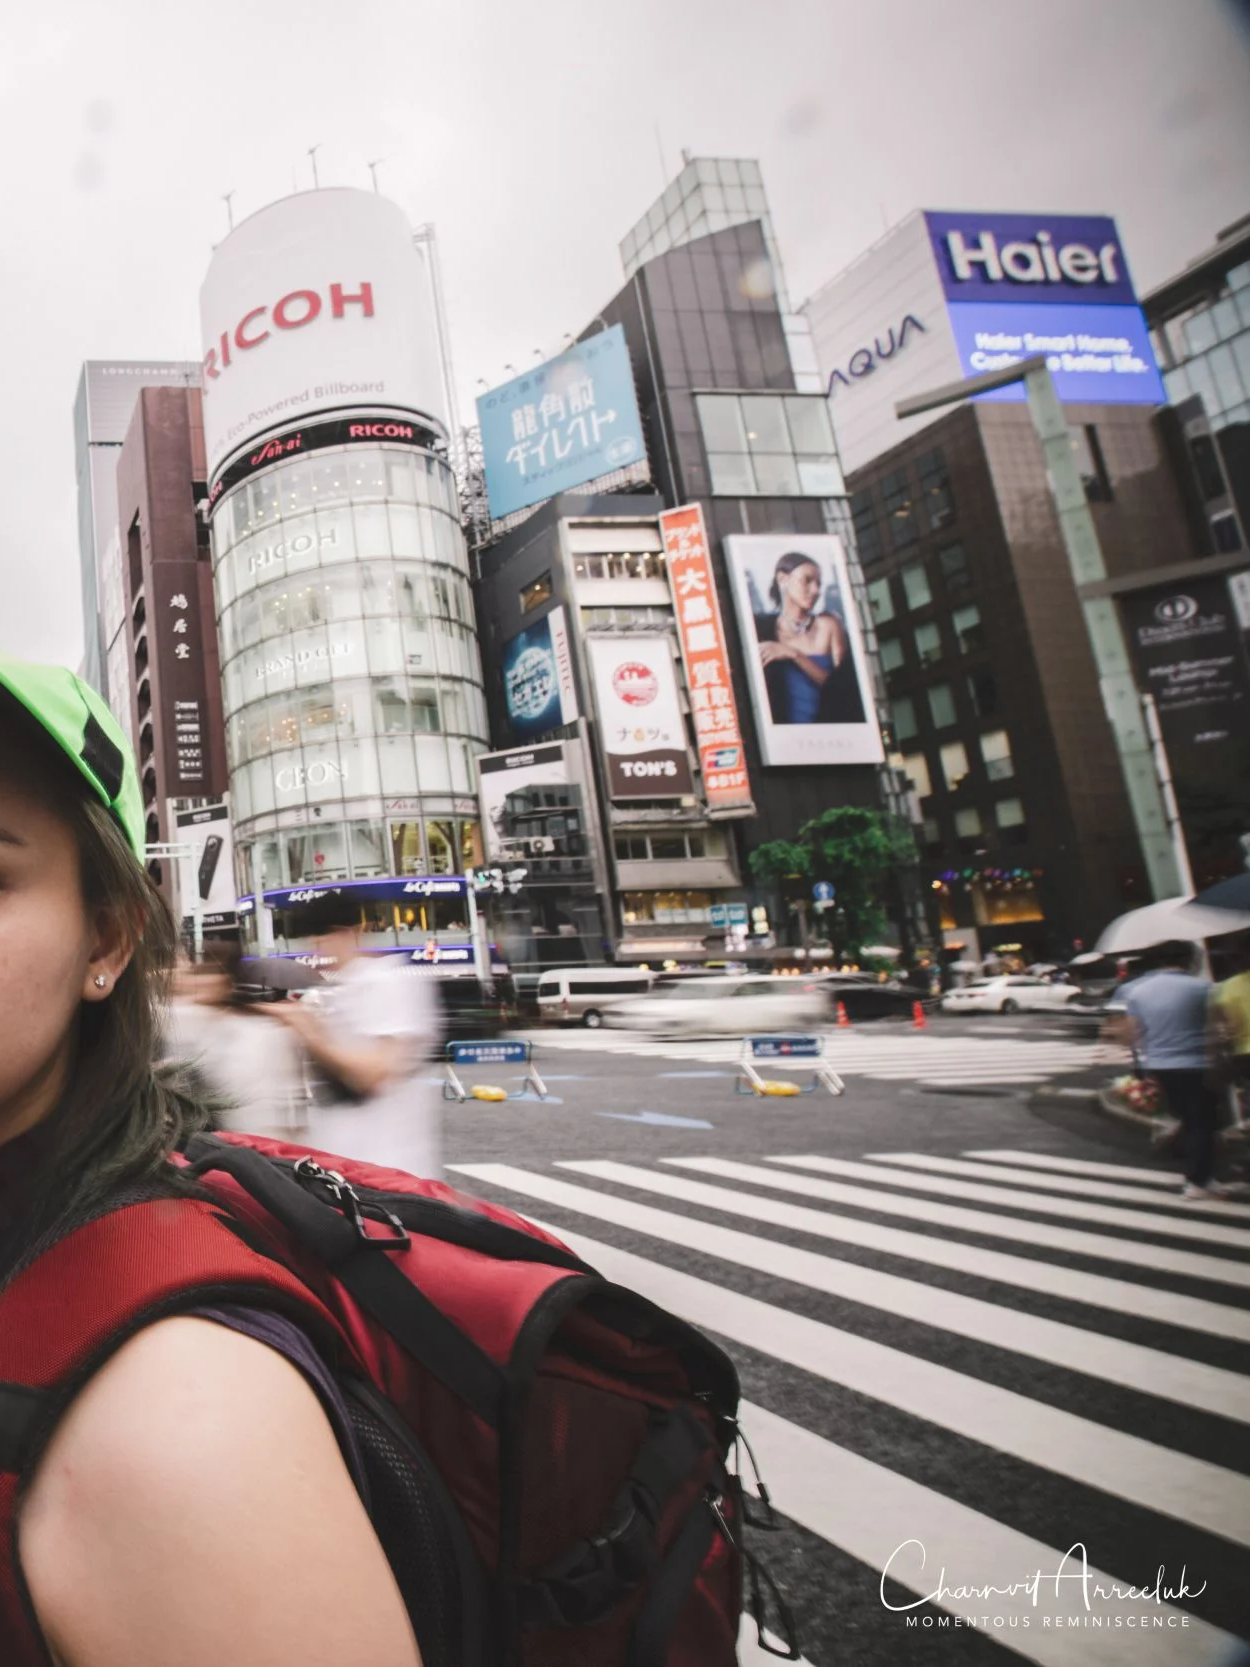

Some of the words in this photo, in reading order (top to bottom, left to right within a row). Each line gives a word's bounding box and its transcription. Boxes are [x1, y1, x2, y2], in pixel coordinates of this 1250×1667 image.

[946, 230, 1120, 284] Haier
[202, 281, 376, 382] RICOH
[827, 314, 926, 398] AQUA
[314, 381, 386, 399] Billboard
[349, 423, 414, 439] RICOH
[247, 528, 339, 576] RICOH
